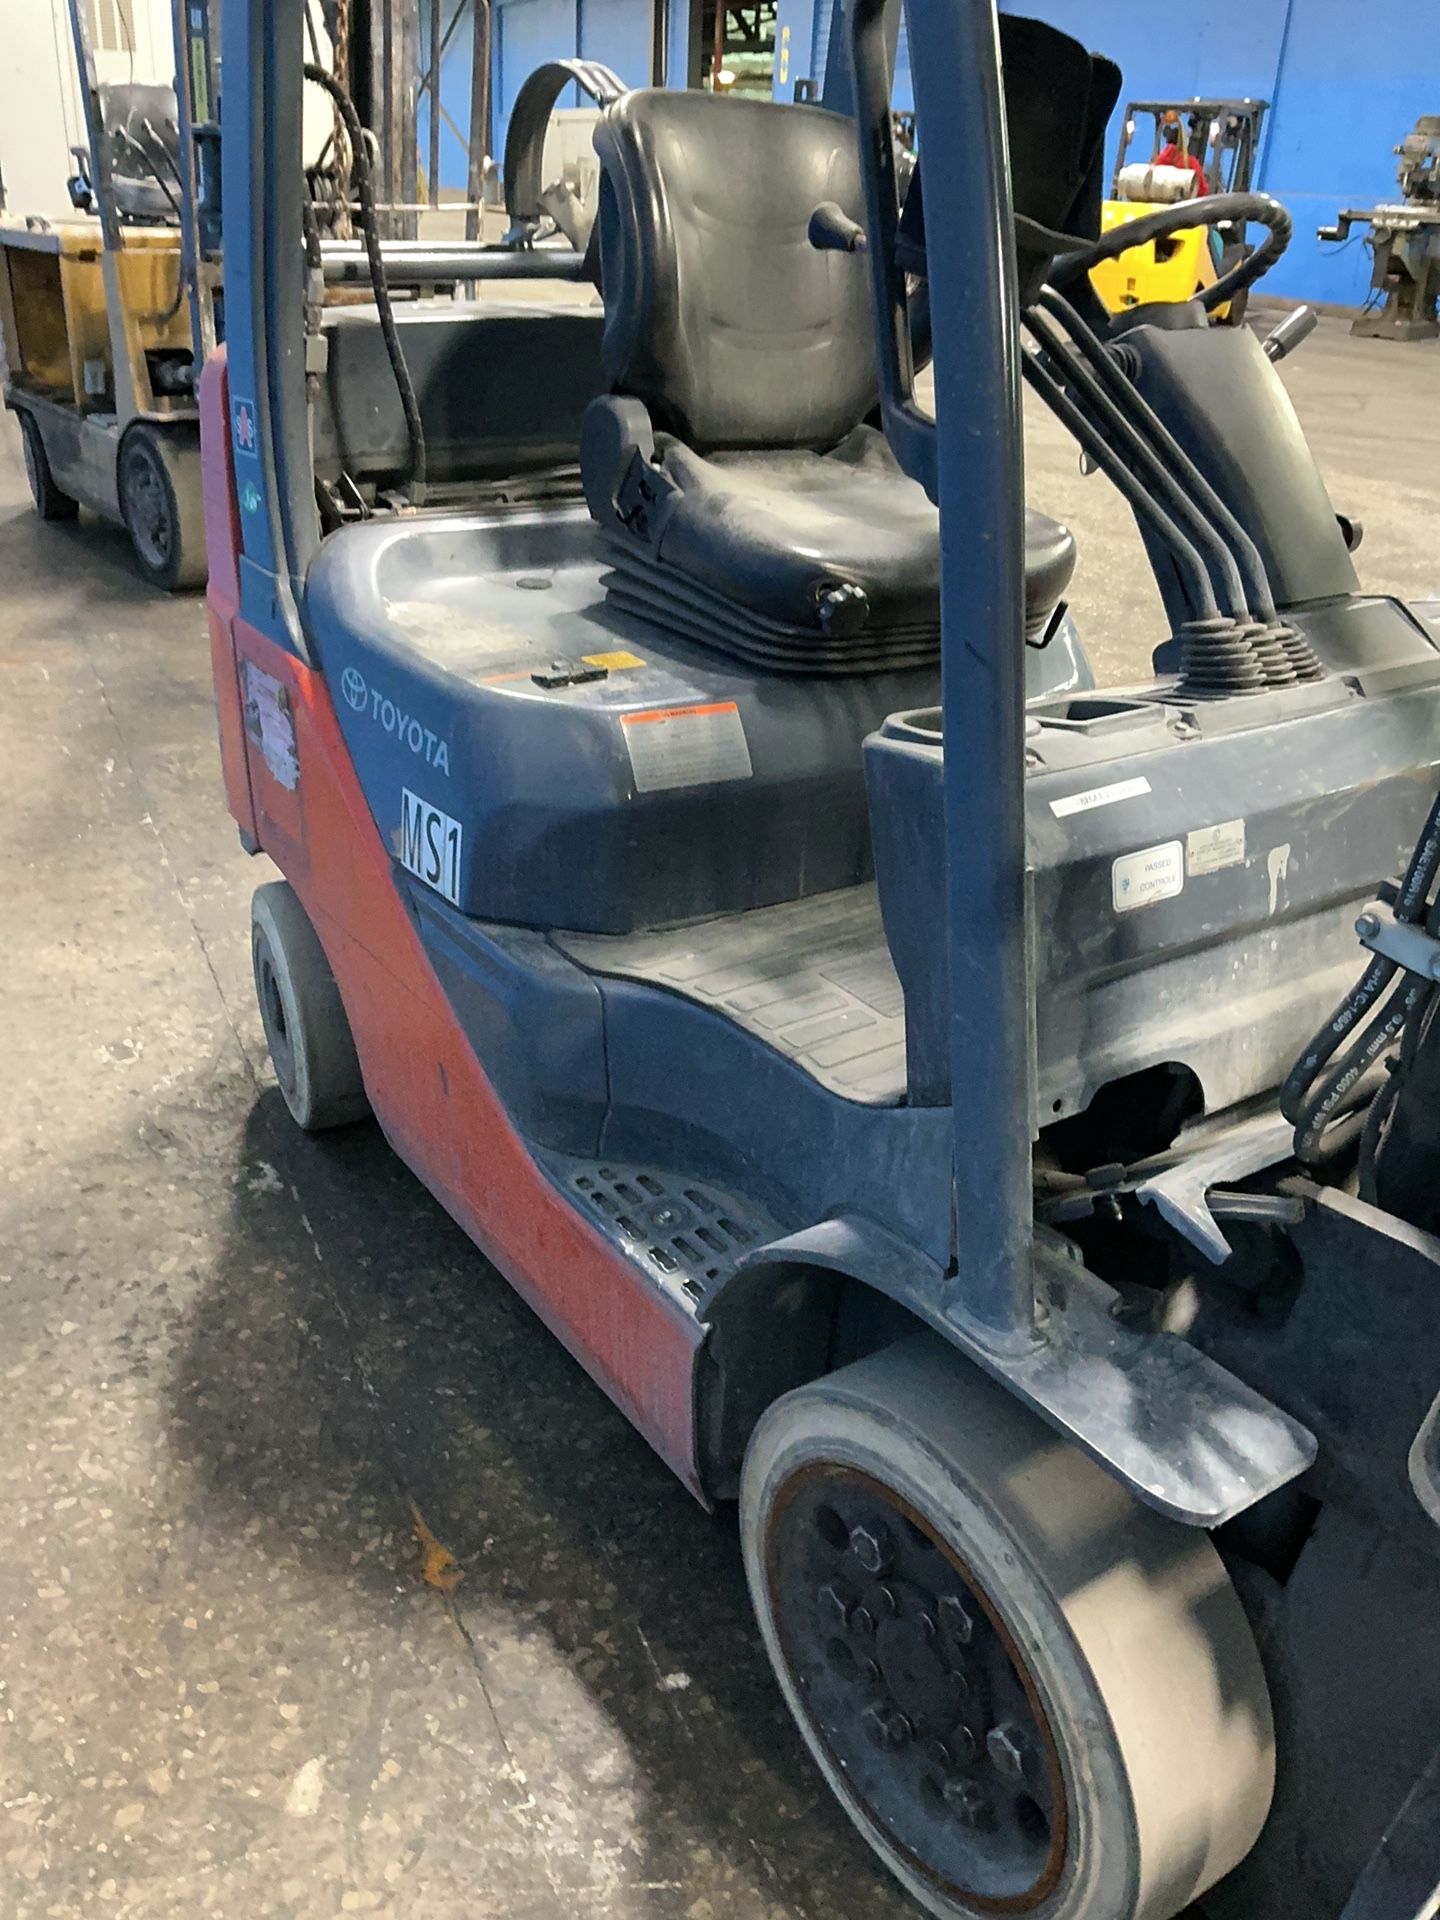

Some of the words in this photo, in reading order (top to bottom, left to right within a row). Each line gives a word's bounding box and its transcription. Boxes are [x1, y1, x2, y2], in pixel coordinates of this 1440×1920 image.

[371, 688, 450, 777] TOYOTA
[403, 793, 459, 899] MS1
[1144, 858, 1171, 872] PASSED
[1336, 1066, 1360, 1093] 4000
[1321, 1091, 1340, 1112] PSI
